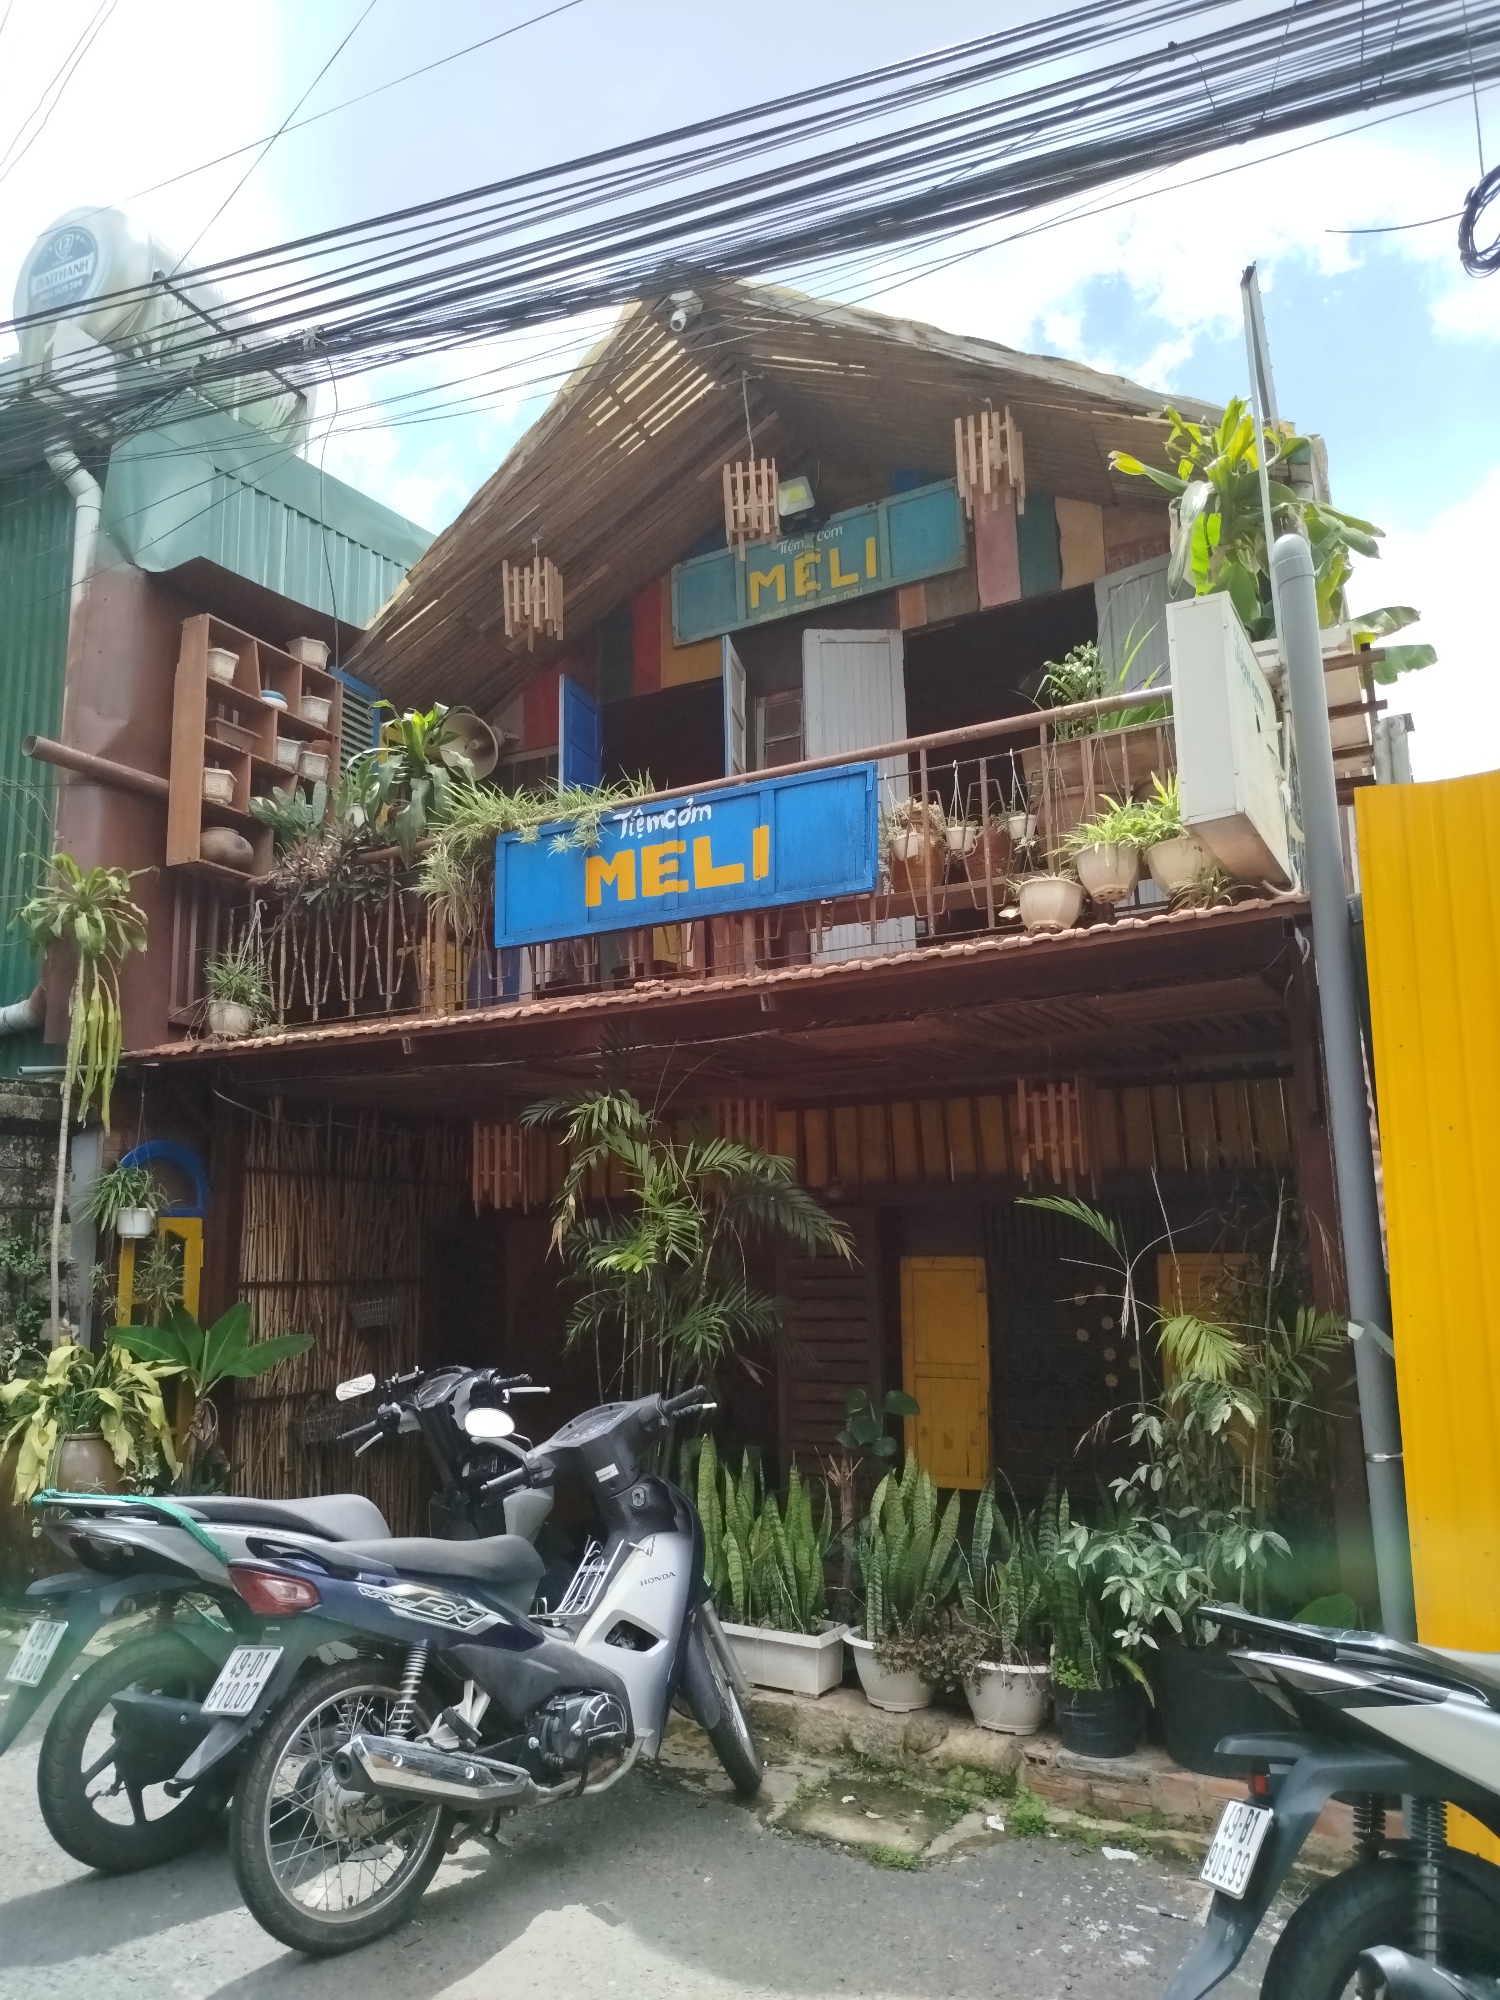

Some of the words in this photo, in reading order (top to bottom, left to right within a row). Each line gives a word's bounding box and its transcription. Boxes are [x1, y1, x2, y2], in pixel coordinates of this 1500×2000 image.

[585, 824, 770, 908] MELI
[639, 1571, 677, 1587] HONDA
[229, 1651, 272, 1679] 49-D1
[207, 1681, 261, 1710] 810.07
[1223, 1804, 1262, 1846] 49-B1
[1204, 1841, 1251, 1889] 909.99
